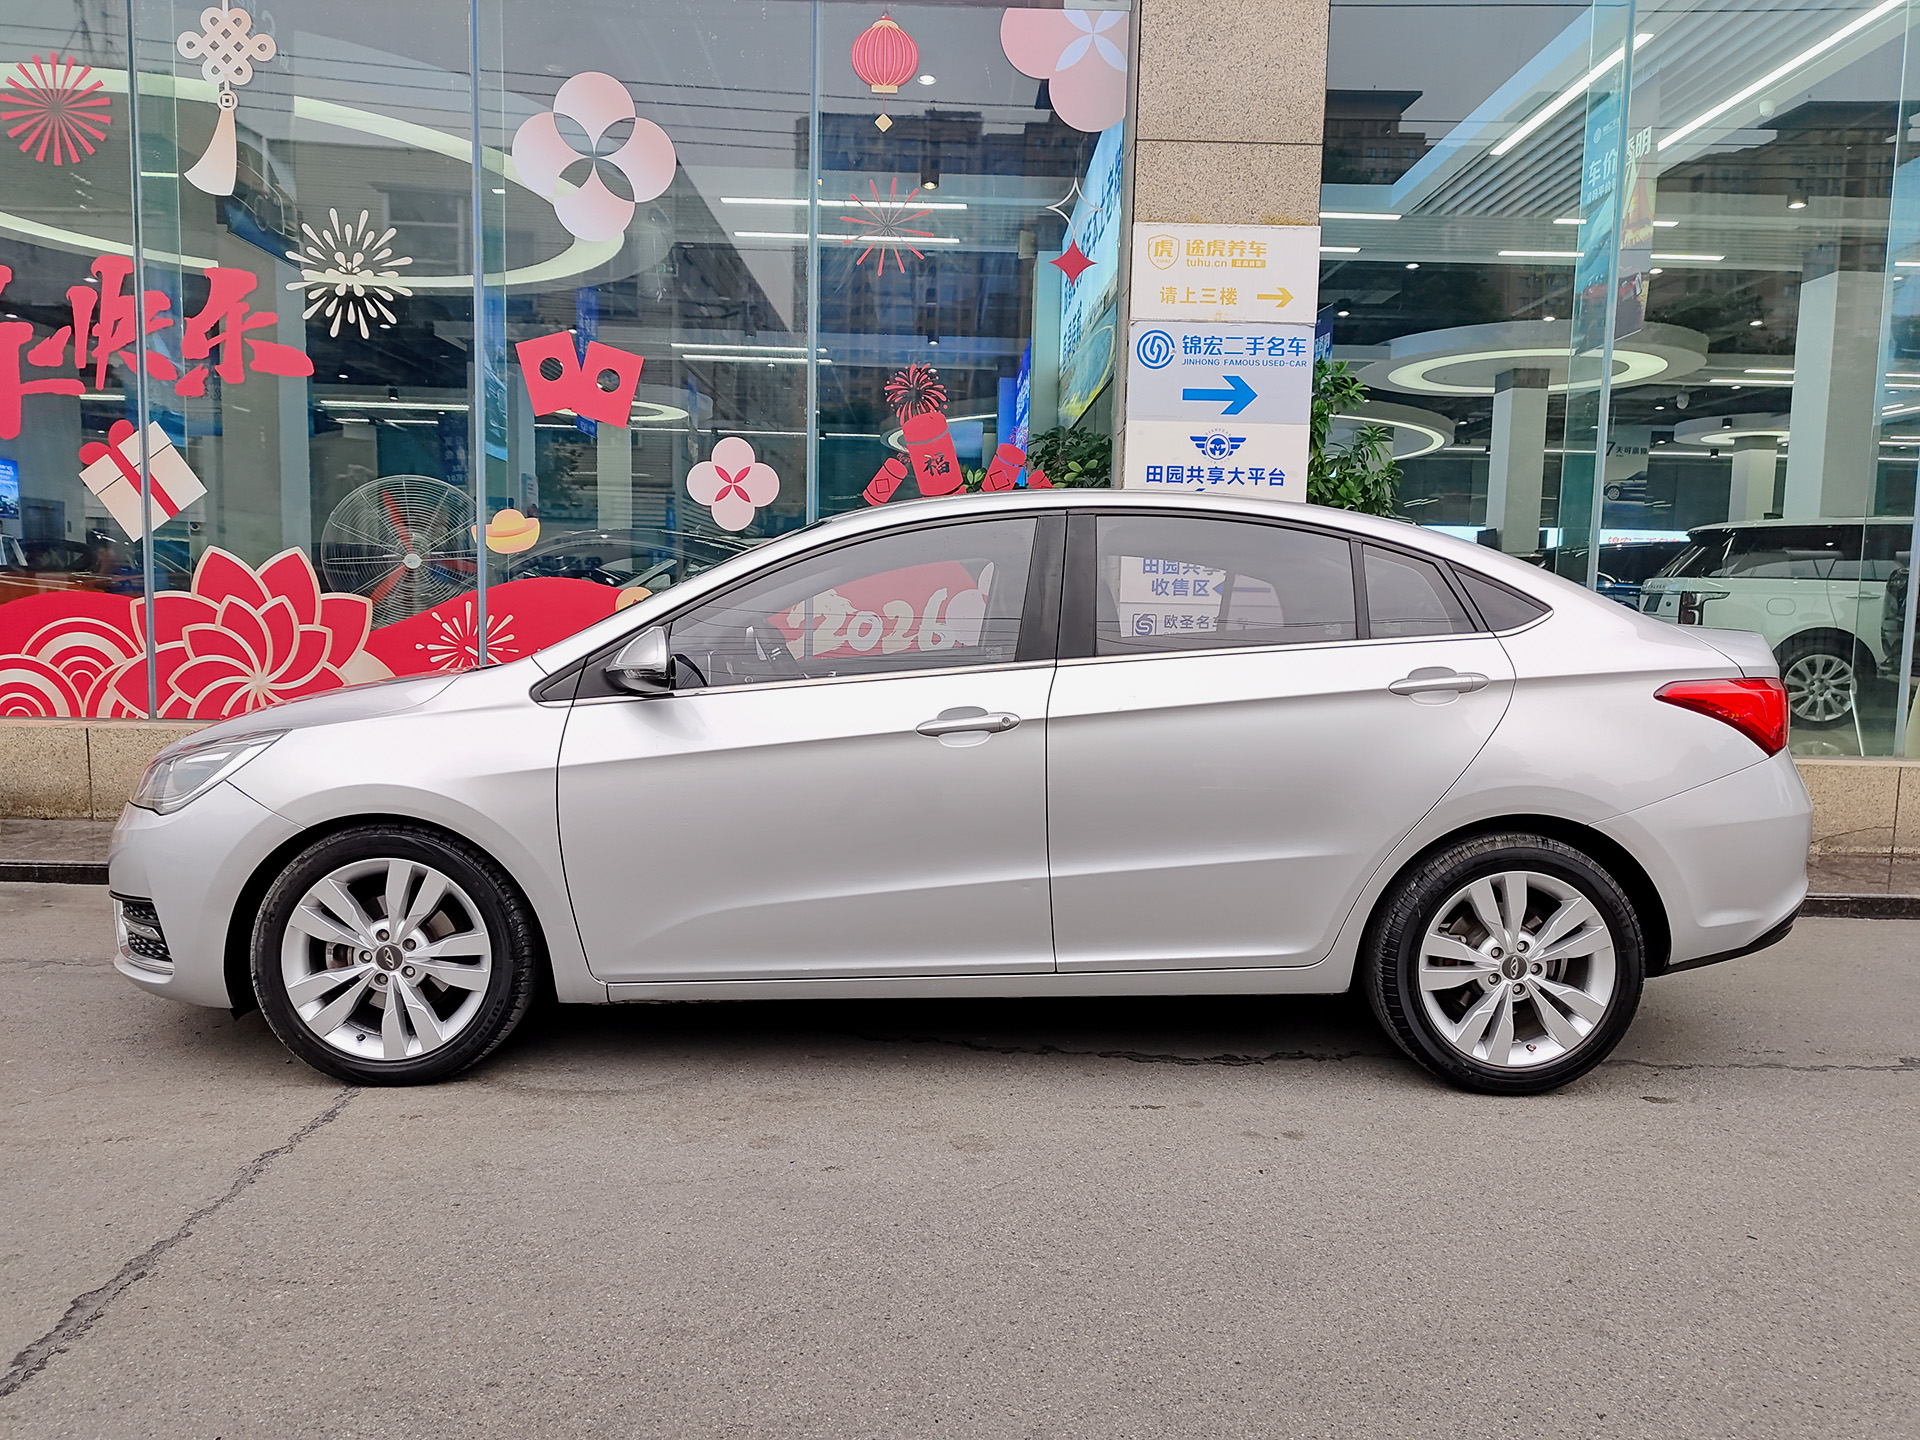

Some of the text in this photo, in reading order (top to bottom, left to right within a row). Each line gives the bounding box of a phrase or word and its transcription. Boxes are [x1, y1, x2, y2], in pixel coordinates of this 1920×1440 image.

[1154, 240, 1174, 257] 虎
[1186, 239, 1267, 257] 途虎养车
[1186, 258, 1228, 268] tuhu.cn
[1160, 286, 1238, 305] 请上三楼
[1182, 335, 1307, 357] 锦宏二手名车
[1223, 359, 1260, 367] FAMOUS
[923, 452, 951, 477] 福
[1145, 465, 1286, 487] 田园共享大平台
[1151, 578, 1210, 597] 收售区
[786, 588, 956, 661] 2026
